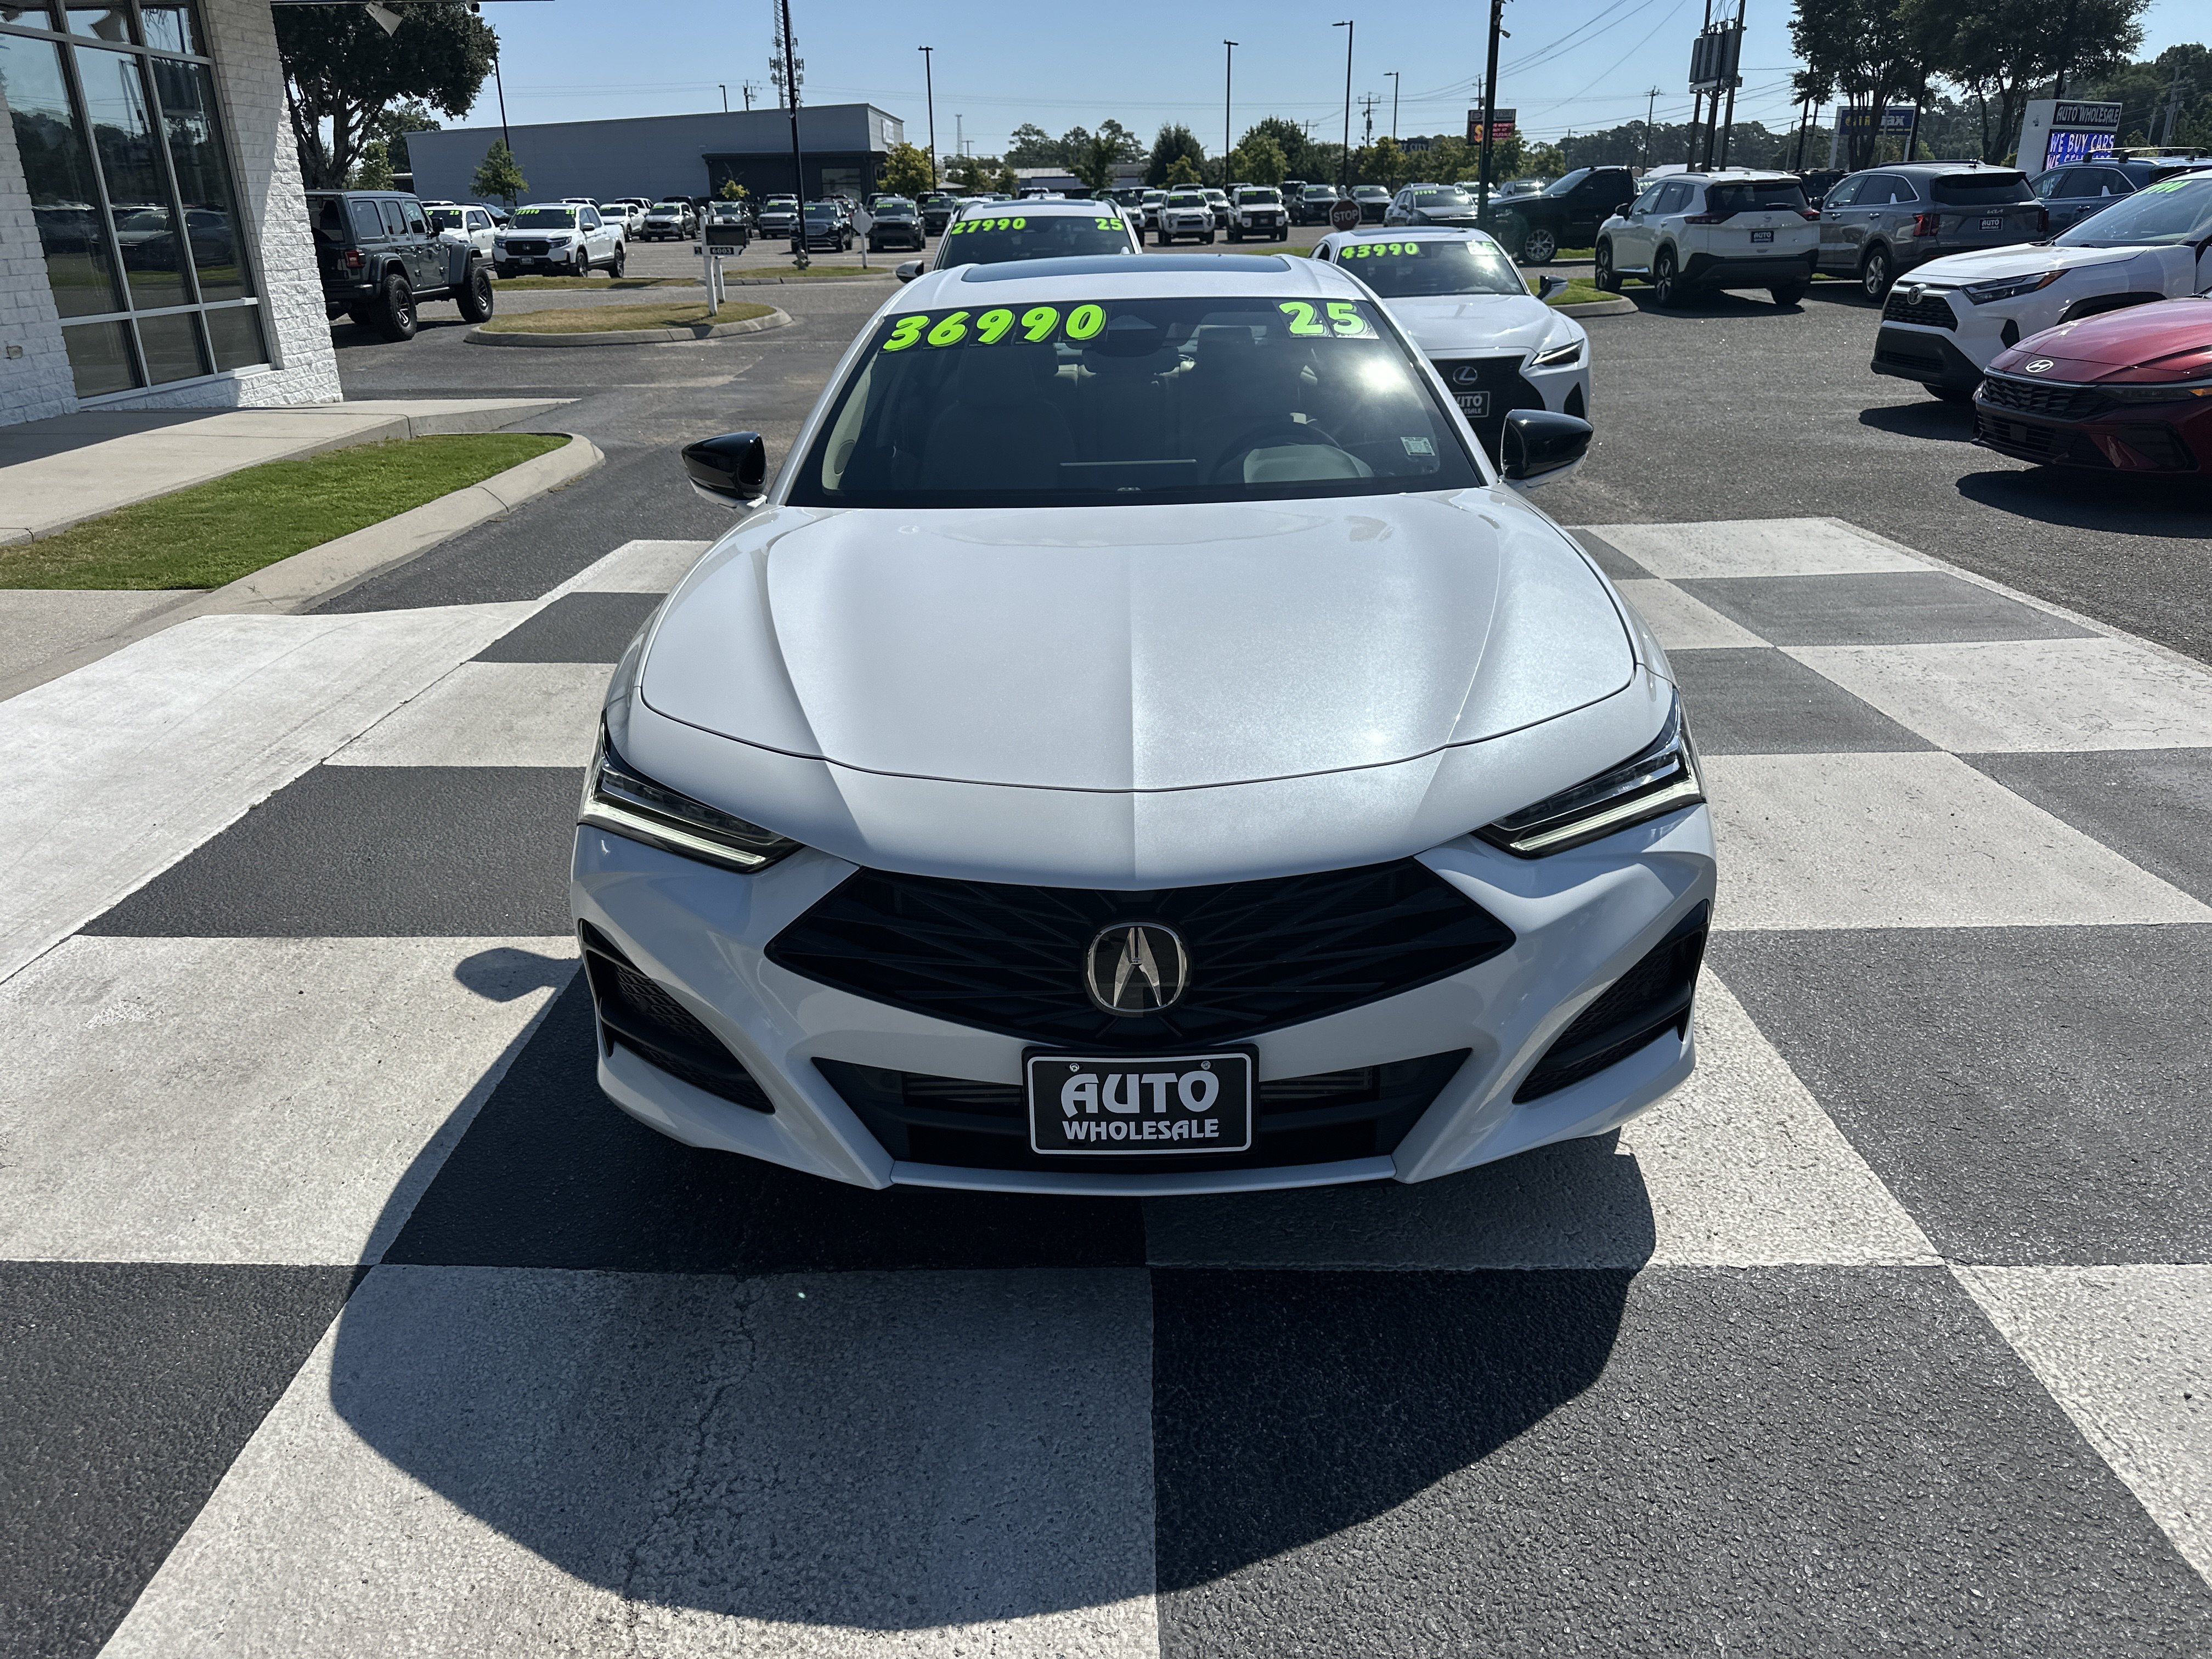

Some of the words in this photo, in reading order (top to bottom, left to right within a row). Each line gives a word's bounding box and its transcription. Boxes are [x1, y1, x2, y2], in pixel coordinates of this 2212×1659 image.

[2056, 106, 2078, 122] AUTO
[2079, 106, 2119, 124] WHOLESALE
[2050, 132, 2066, 153] WE
[2067, 133, 2089, 154] BUY
[2090, 134, 2115, 151] CARS
[1333, 209, 1358, 222] STOP
[951, 218, 1027, 235] 27990
[1094, 218, 1124, 230] 25
[1341, 242, 1419, 259] 43990
[882, 304, 1107, 351] 36990
[1279, 301, 1368, 335] 25
[1454, 395, 1483, 408] UTO
[1061, 1070, 1219, 1118] AUTO
[1062, 1119, 1220, 1142] WHOLESALE
